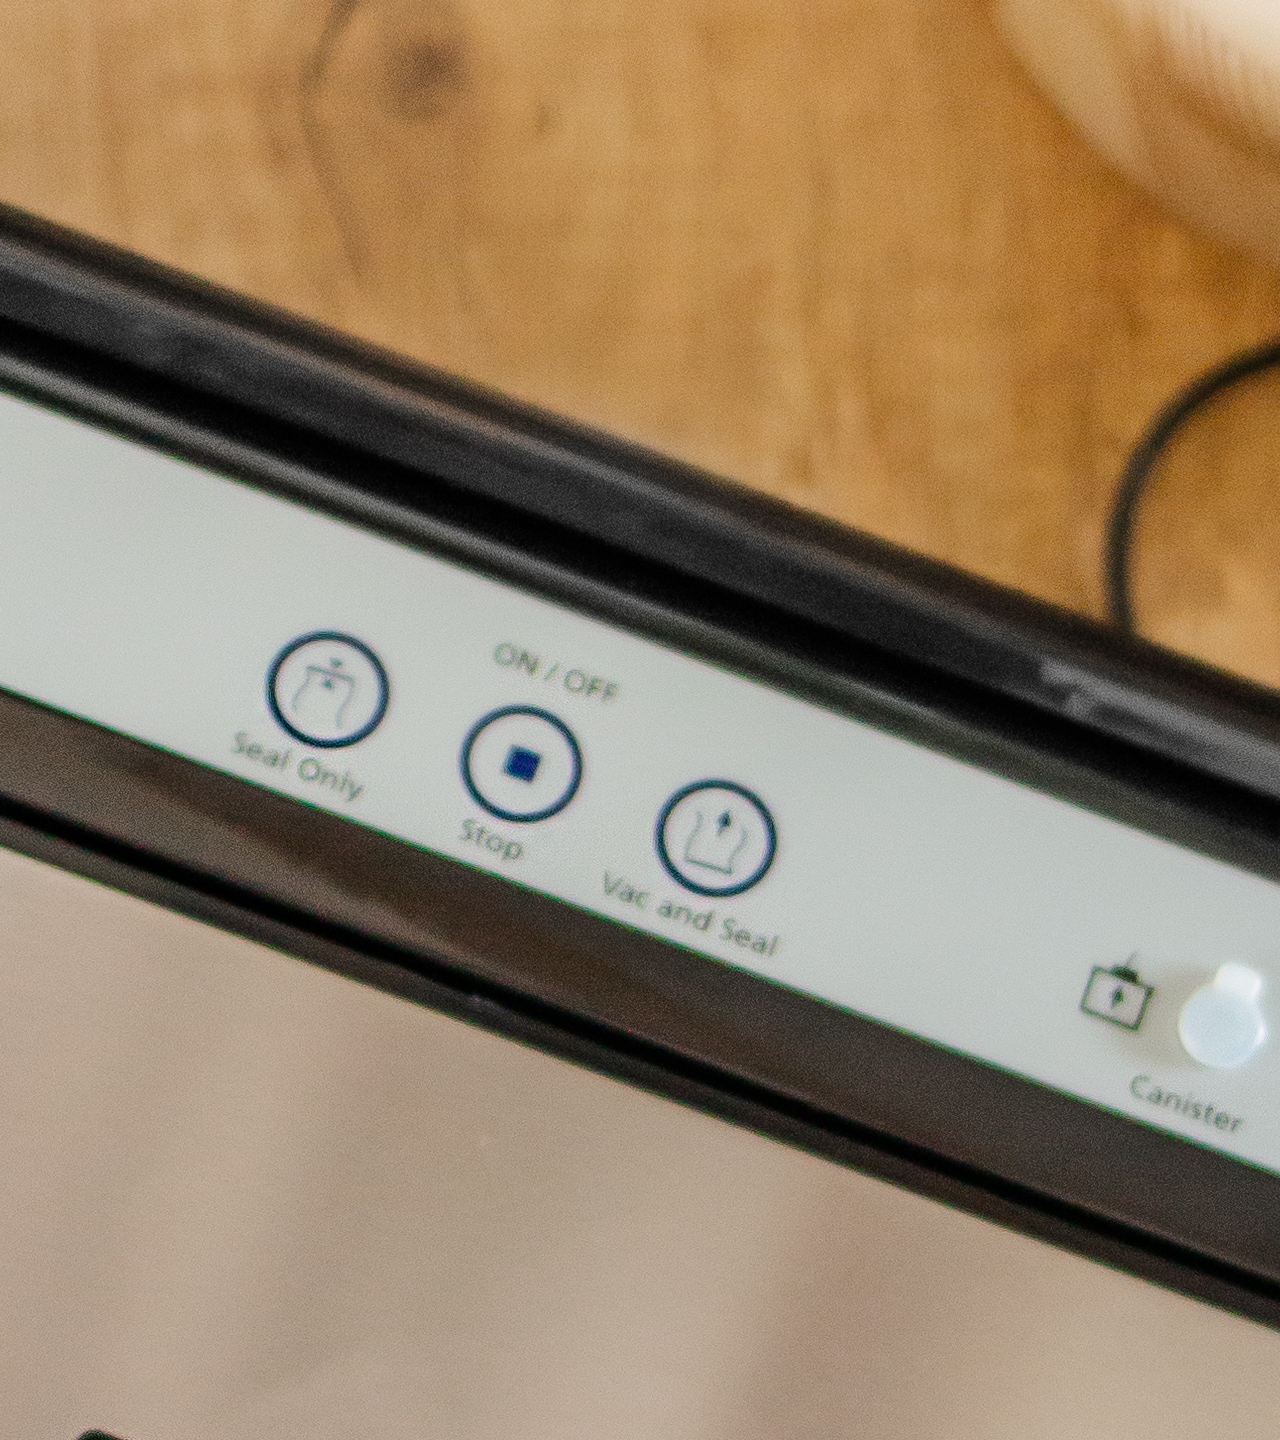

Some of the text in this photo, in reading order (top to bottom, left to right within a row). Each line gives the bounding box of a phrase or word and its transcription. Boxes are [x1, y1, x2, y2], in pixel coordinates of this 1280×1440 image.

[493, 642, 620, 701] ON / OFF
[231, 730, 365, 803] Seal Only
[459, 818, 524, 862] Stop
[603, 869, 780, 957] Vac and Seal
[1128, 1073, 1245, 1133] Canister
